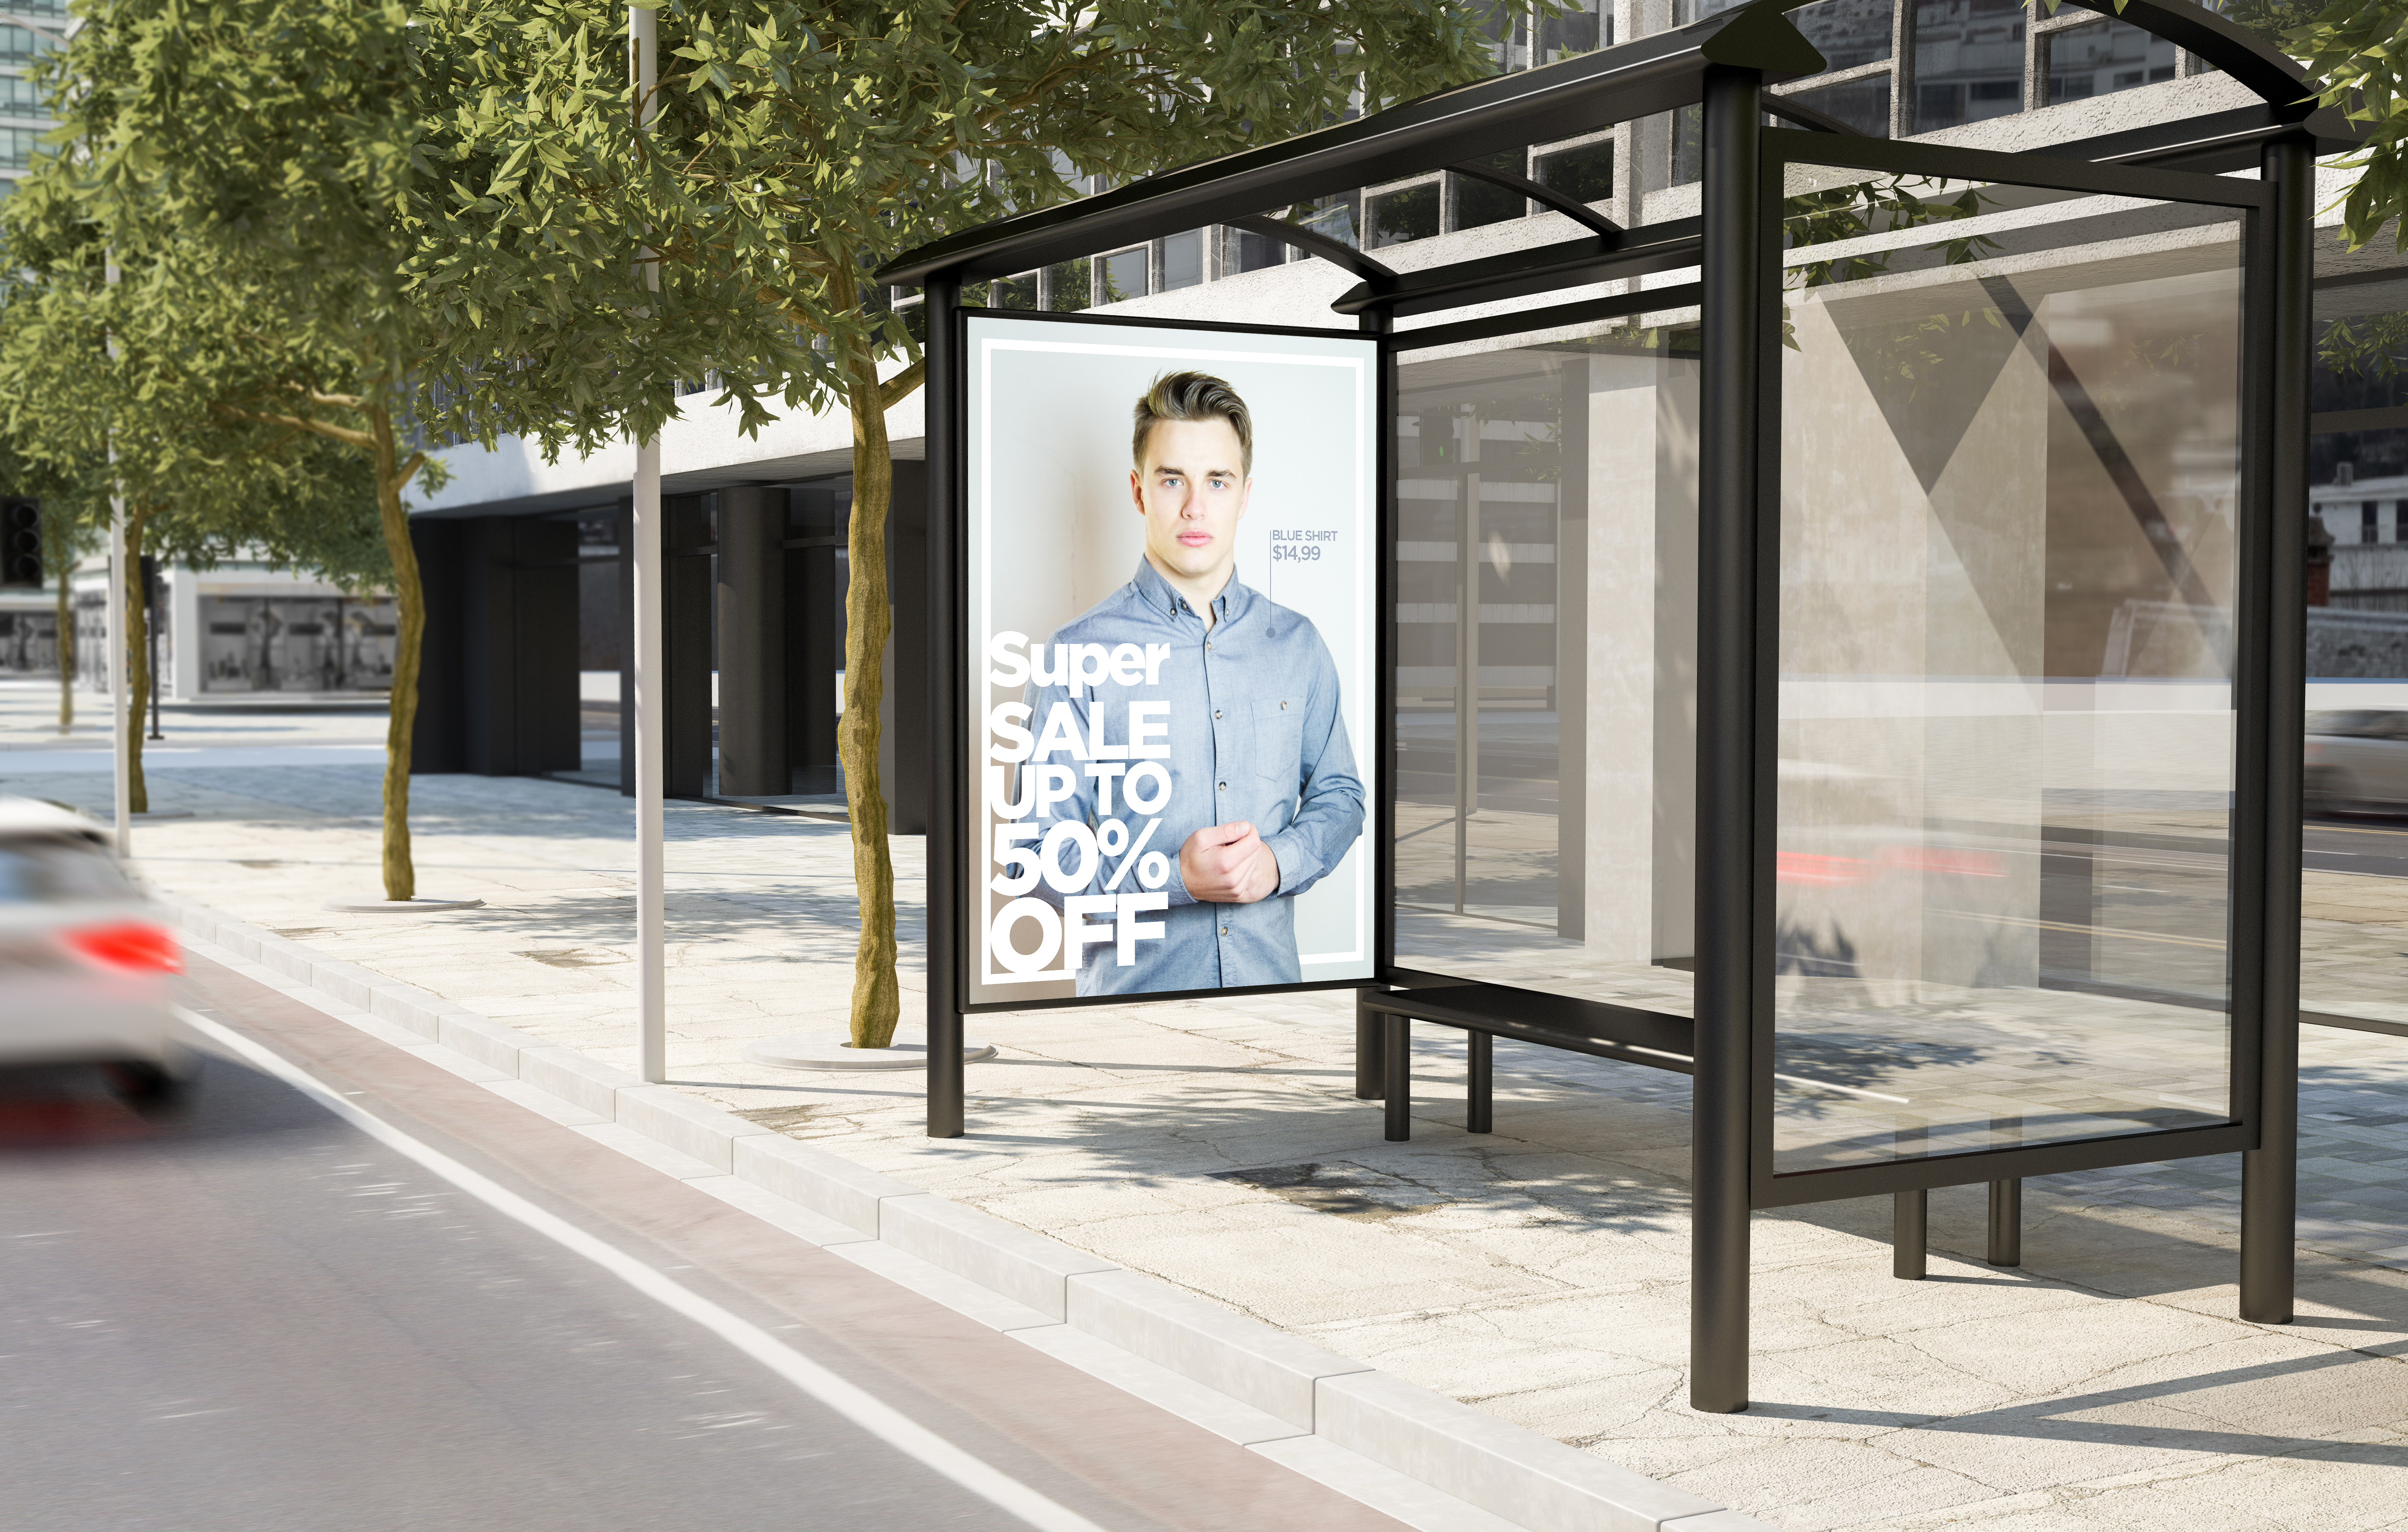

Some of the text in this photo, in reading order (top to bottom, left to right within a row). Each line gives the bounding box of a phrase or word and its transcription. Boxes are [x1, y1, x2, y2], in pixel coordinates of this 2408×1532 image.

[1272, 530, 1338, 541] BLUE SHIRT
[1272, 544, 1321, 563] $14,99
[990, 631, 1170, 698] Super
[990, 701, 1171, 763] SALE
[990, 761, 1172, 819] UP TO
[990, 818, 1170, 896] 50%
[990, 892, 1169, 973] OFF
